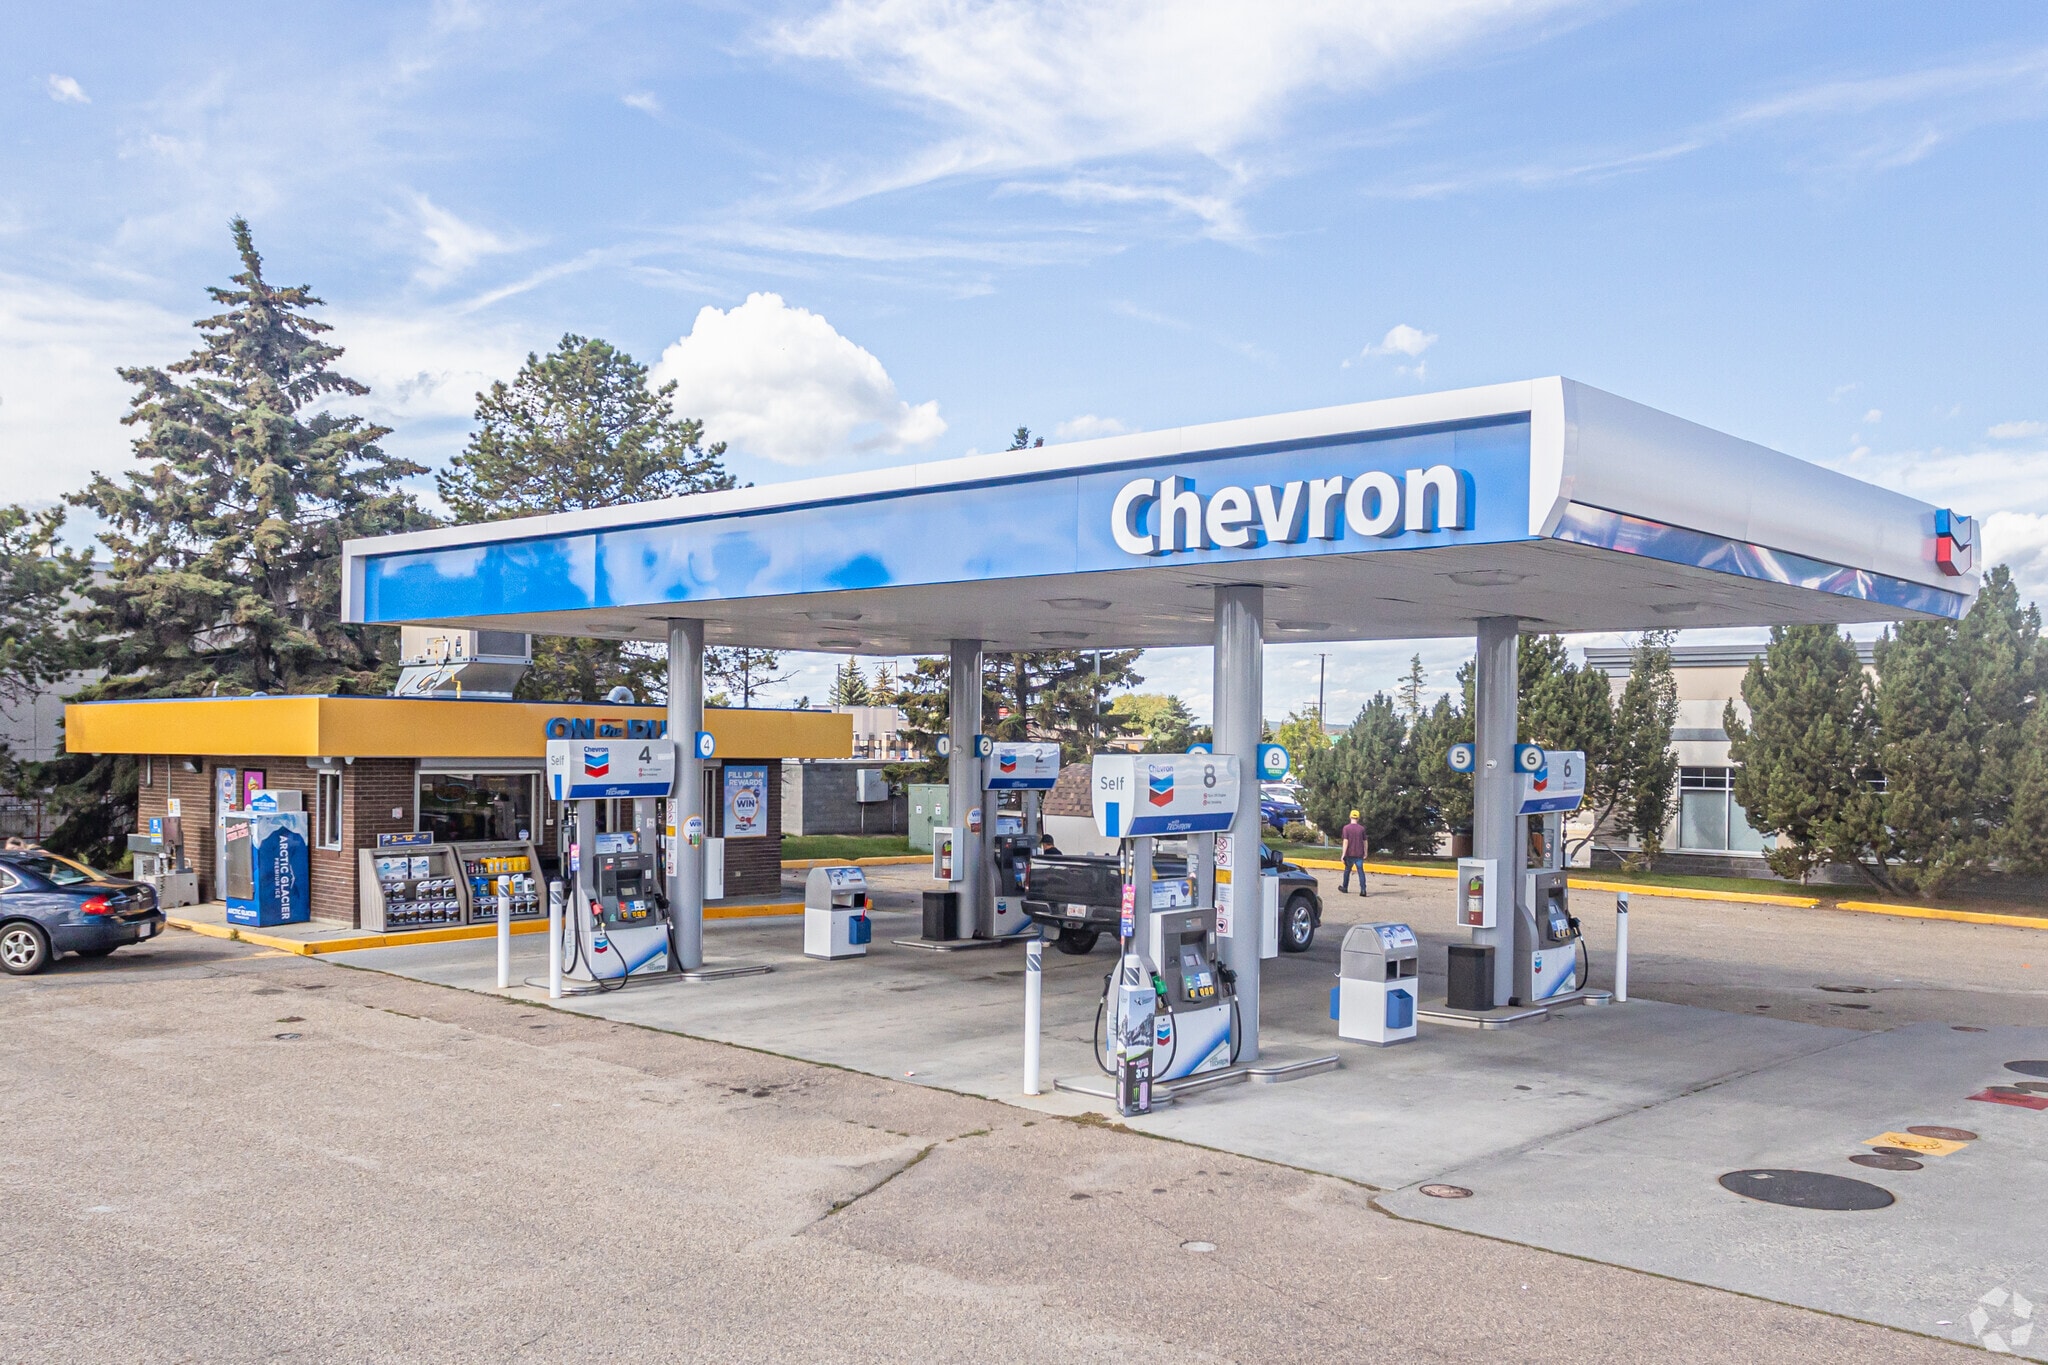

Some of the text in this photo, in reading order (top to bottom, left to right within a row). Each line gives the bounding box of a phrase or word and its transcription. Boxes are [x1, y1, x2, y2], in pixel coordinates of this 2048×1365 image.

[1111, 464, 1464, 556] Chevron
[546, 717, 595, 739] ON
[600, 724, 624, 737] the
[703, 739, 710, 751] 4
[942, 741, 947, 750] 1
[982, 741, 989, 751] 2
[551, 755, 565, 766] Self
[638, 746, 652, 764] 4
[1035, 749, 1043, 763] 2
[1271, 753, 1280, 766] 8
[1456, 751, 1465, 763] 5
[1526, 752, 1536, 765] 6
[1564, 759, 1571, 777] 6
[728, 771, 742, 779] FILL
[743, 771, 753, 779] UP
[1203, 764, 1217, 788] 8
[1101, 776, 1125, 791] Self
[736, 800, 755, 808] WIN
[279, 835, 291, 920] ARCTIC GLACIER
